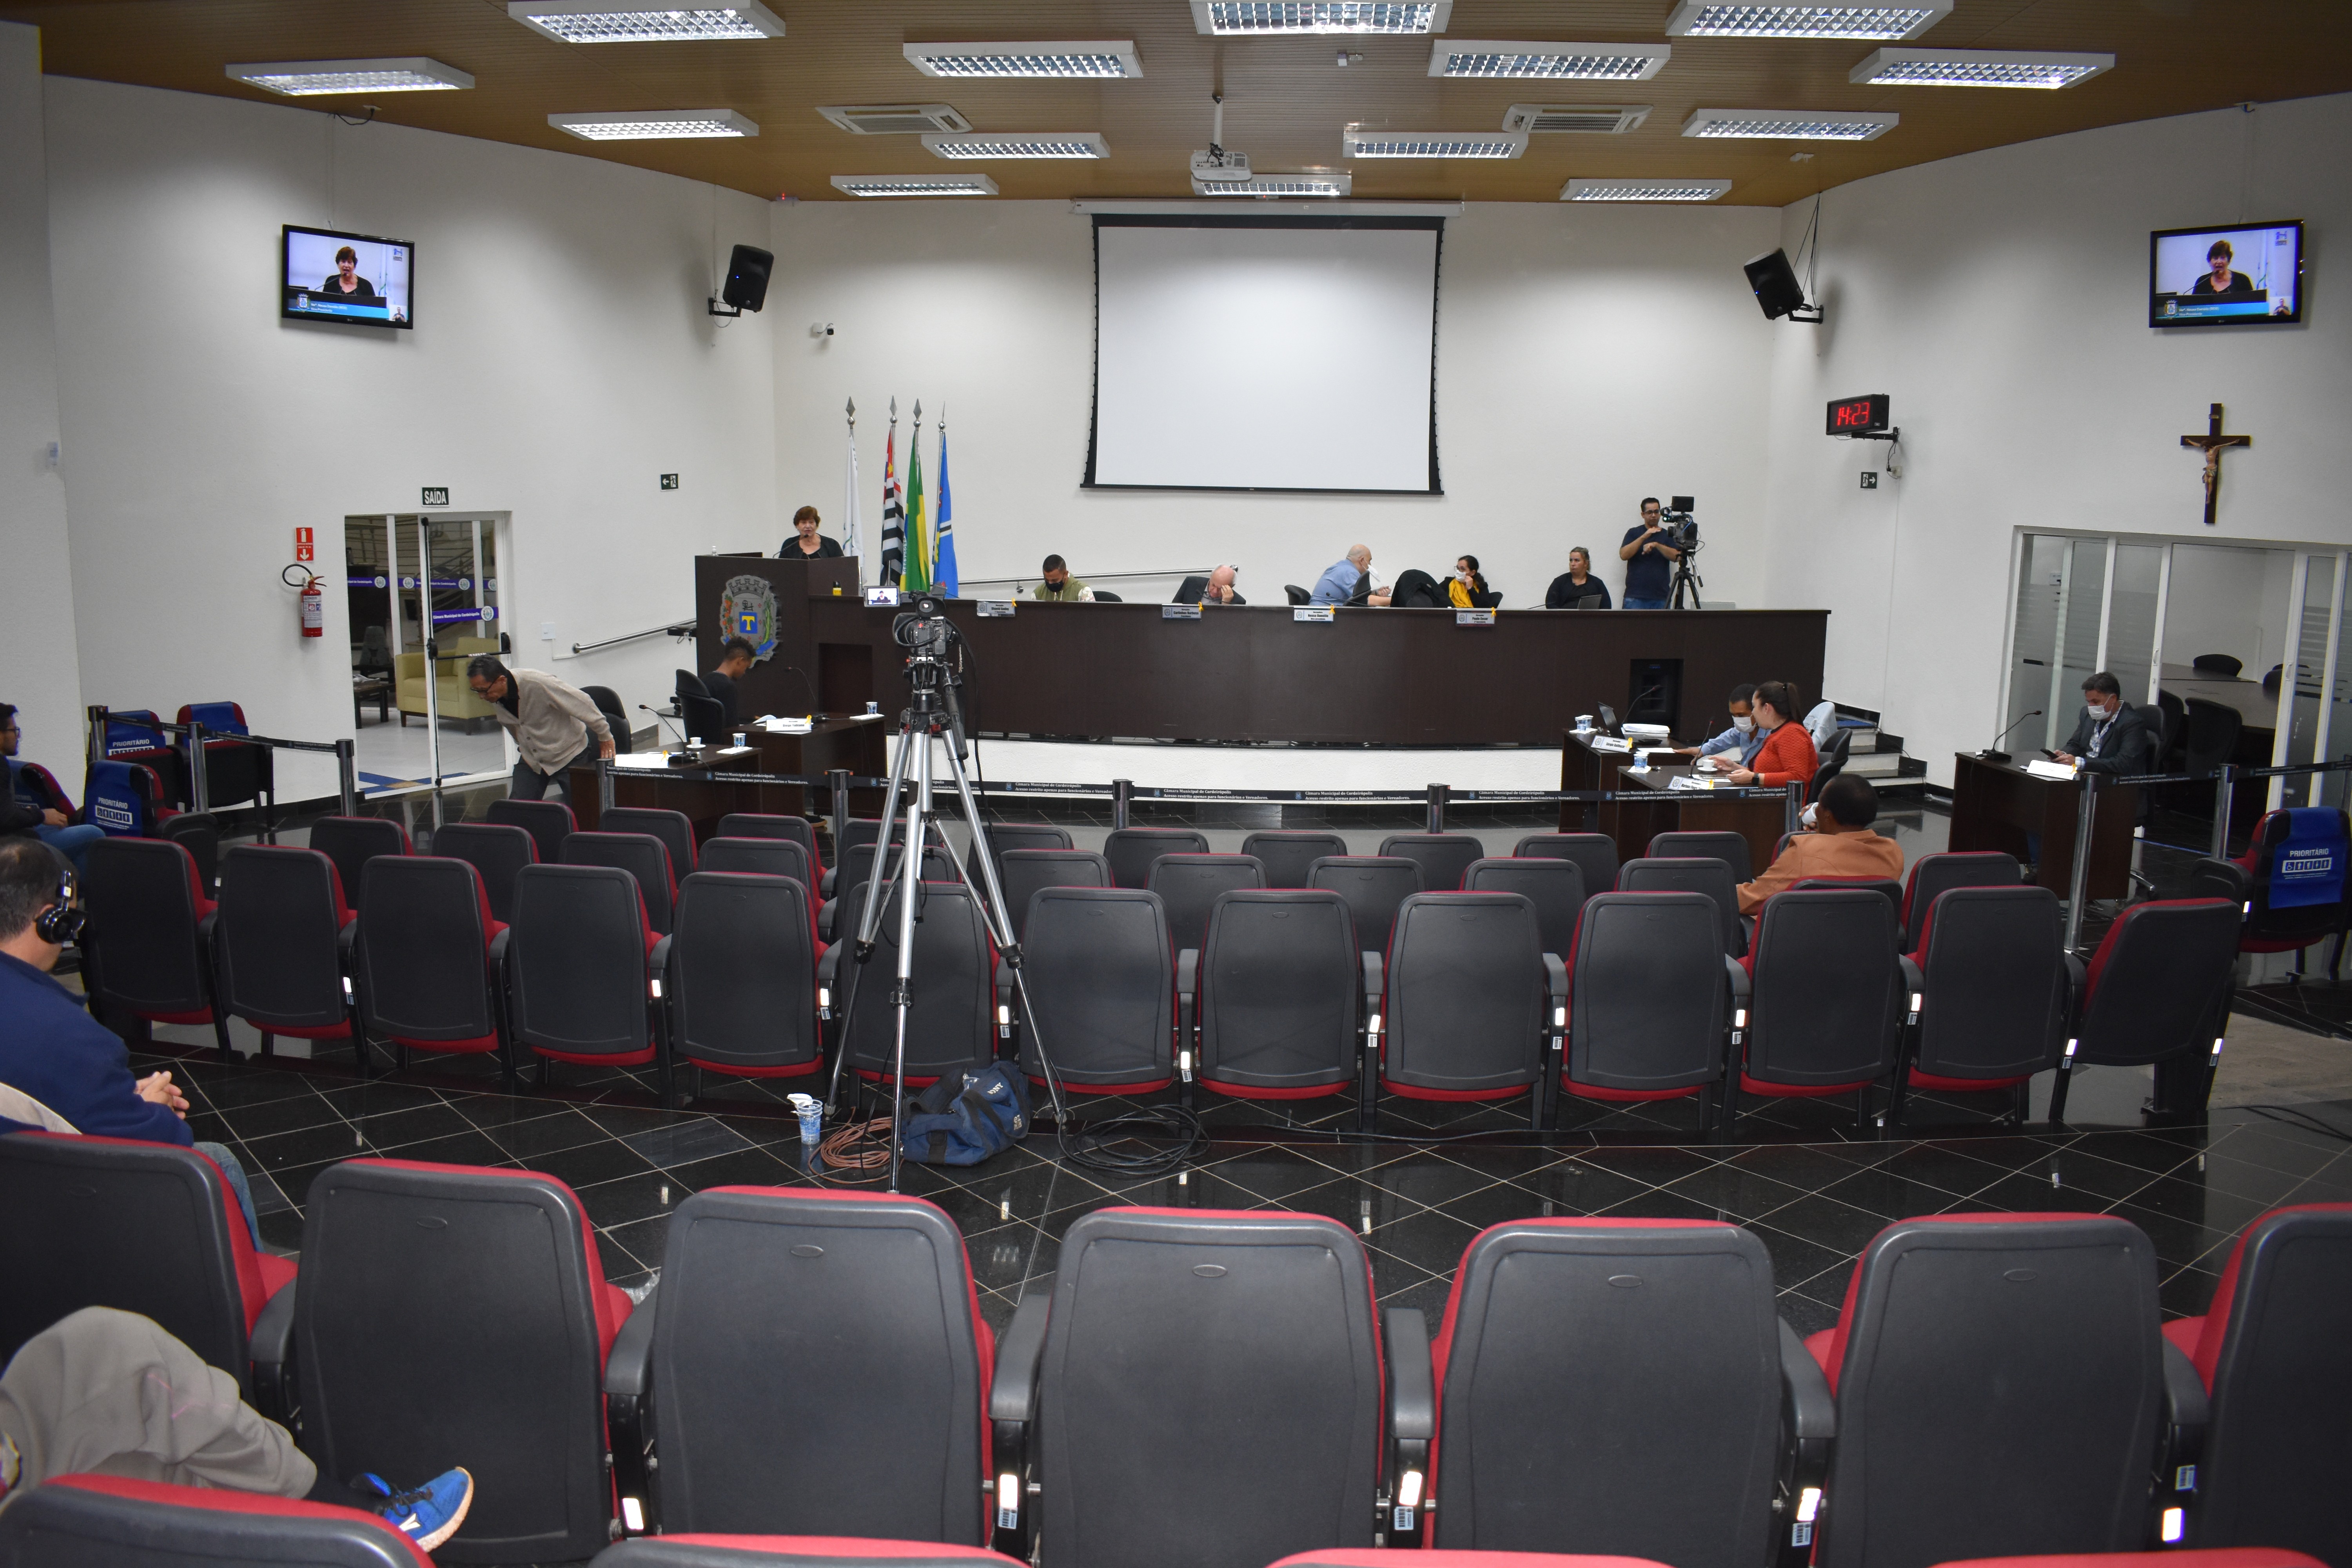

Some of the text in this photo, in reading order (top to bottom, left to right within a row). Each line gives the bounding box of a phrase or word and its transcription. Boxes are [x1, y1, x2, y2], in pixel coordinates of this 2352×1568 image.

[1837, 402, 1870, 426] 14:23
[425, 488, 447, 504] SAÍDA
[98, 797, 128, 809] PRIORITÁRIO
[2290, 848, 2329, 857] PRIORITÁRIO
